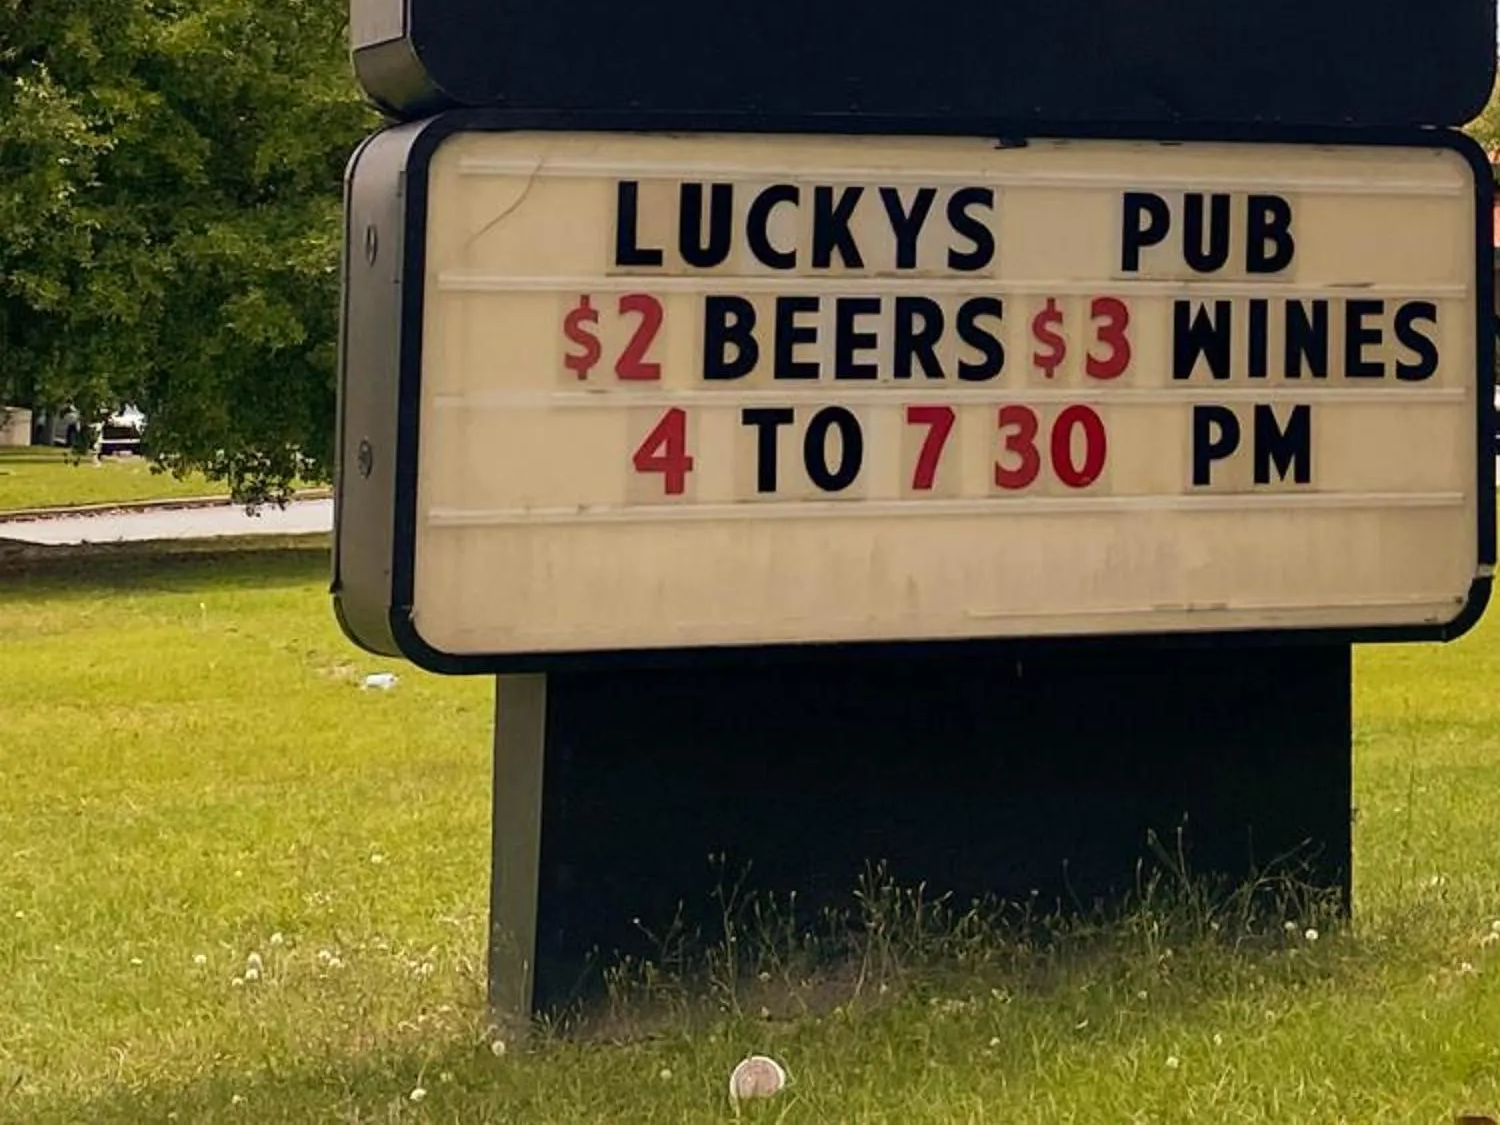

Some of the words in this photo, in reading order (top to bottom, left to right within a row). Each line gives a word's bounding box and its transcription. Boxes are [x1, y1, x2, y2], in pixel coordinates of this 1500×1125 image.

[615, 181, 996, 271] LUCKYS
[1121, 192, 1296, 274] PUB
[563, 294, 662, 380] $2
[702, 295, 1005, 382] BEERS
[1032, 297, 1130, 379] $3
[1172, 299, 1439, 382] WINES
[632, 408, 692, 495] 4
[741, 405, 863, 493] TO
[1192, 404, 1311, 486] PM
